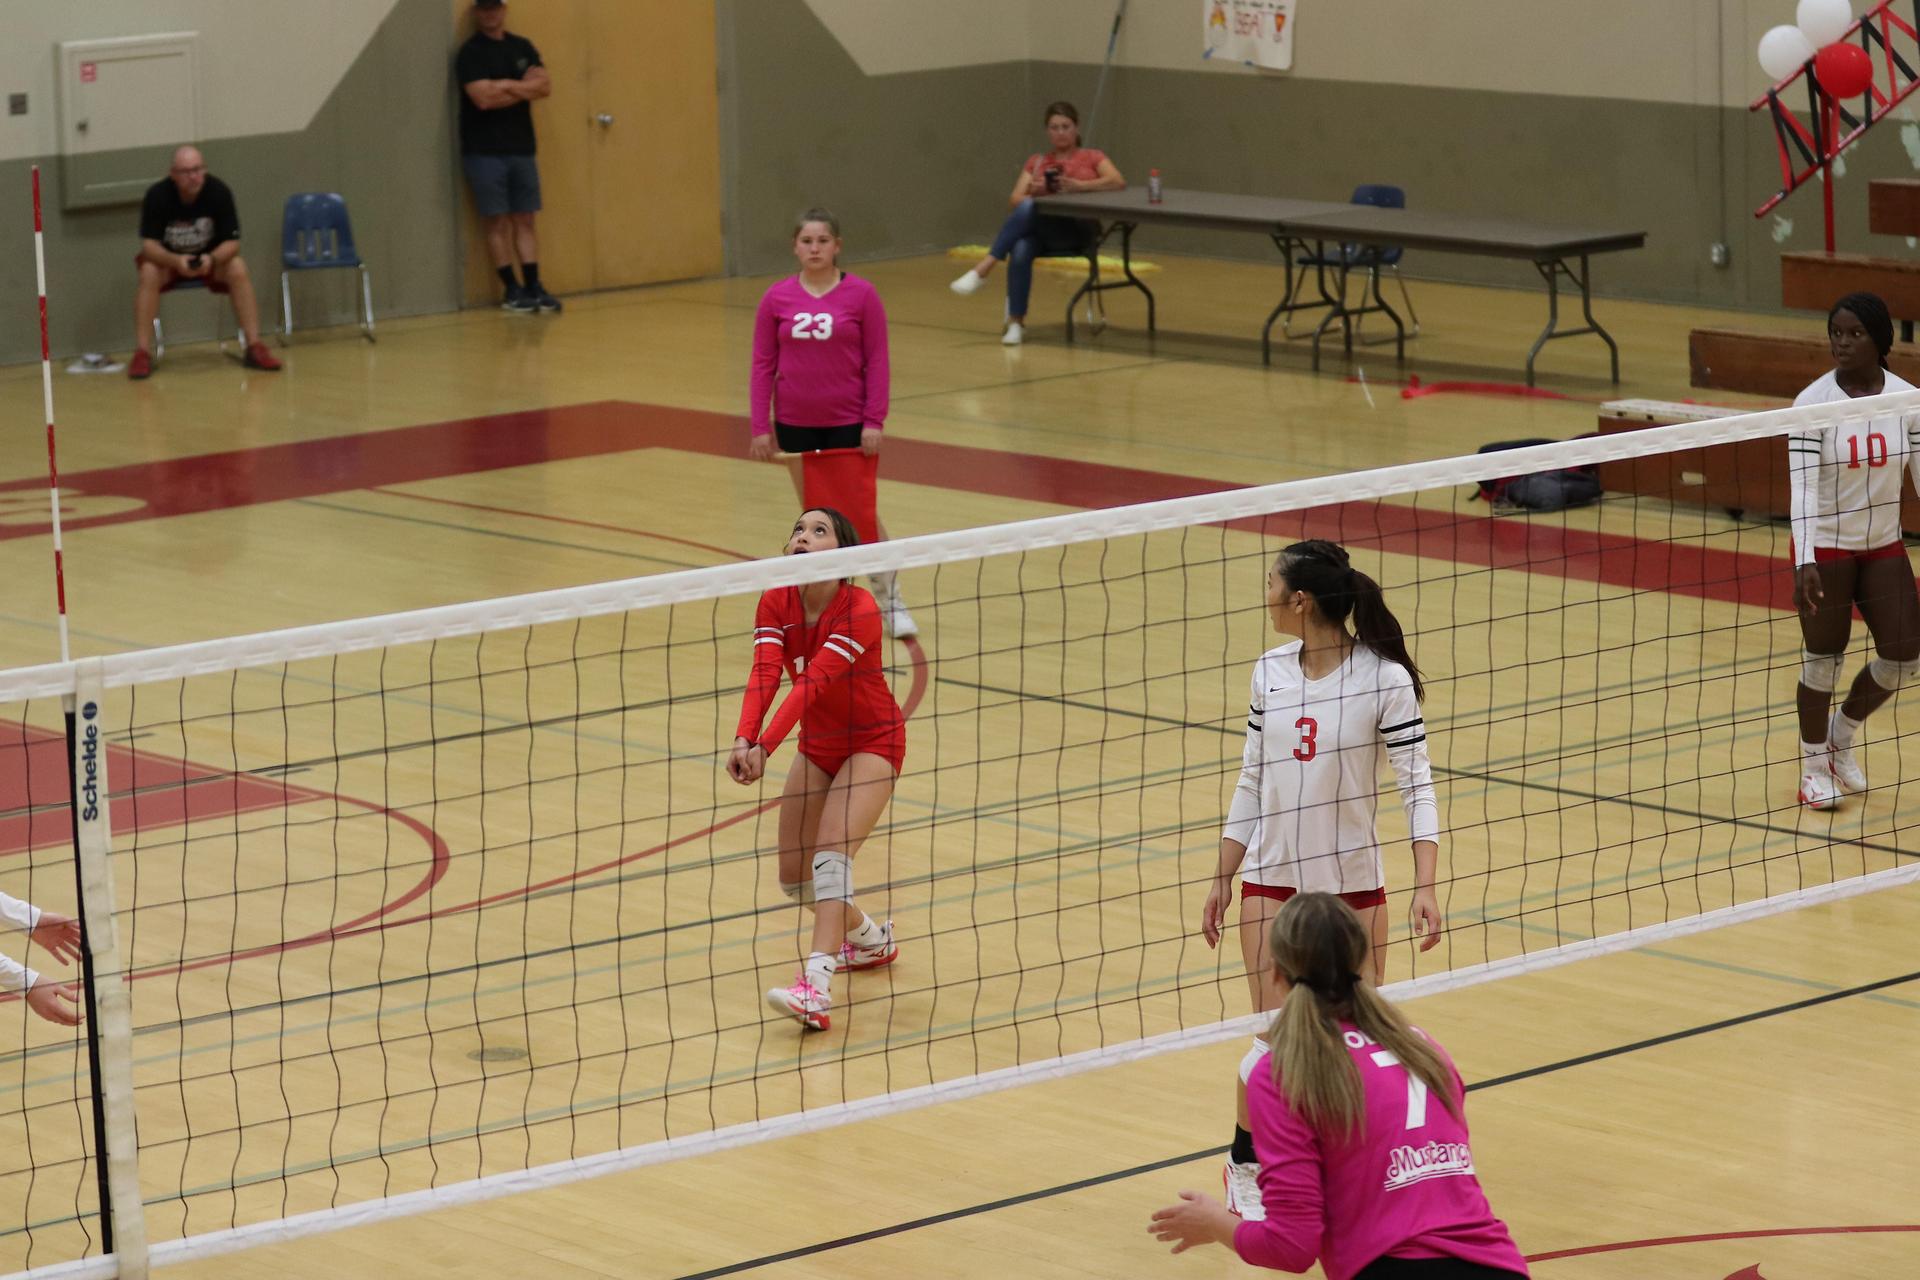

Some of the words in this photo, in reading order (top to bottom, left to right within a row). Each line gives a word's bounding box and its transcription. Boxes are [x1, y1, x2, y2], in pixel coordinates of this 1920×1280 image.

[791, 312, 833, 340] 23
[1846, 432, 1888, 469] 10
[1292, 716, 1318, 762] 3
[81, 723, 99, 822] Schelde
[1369, 1050, 1428, 1130] 7
